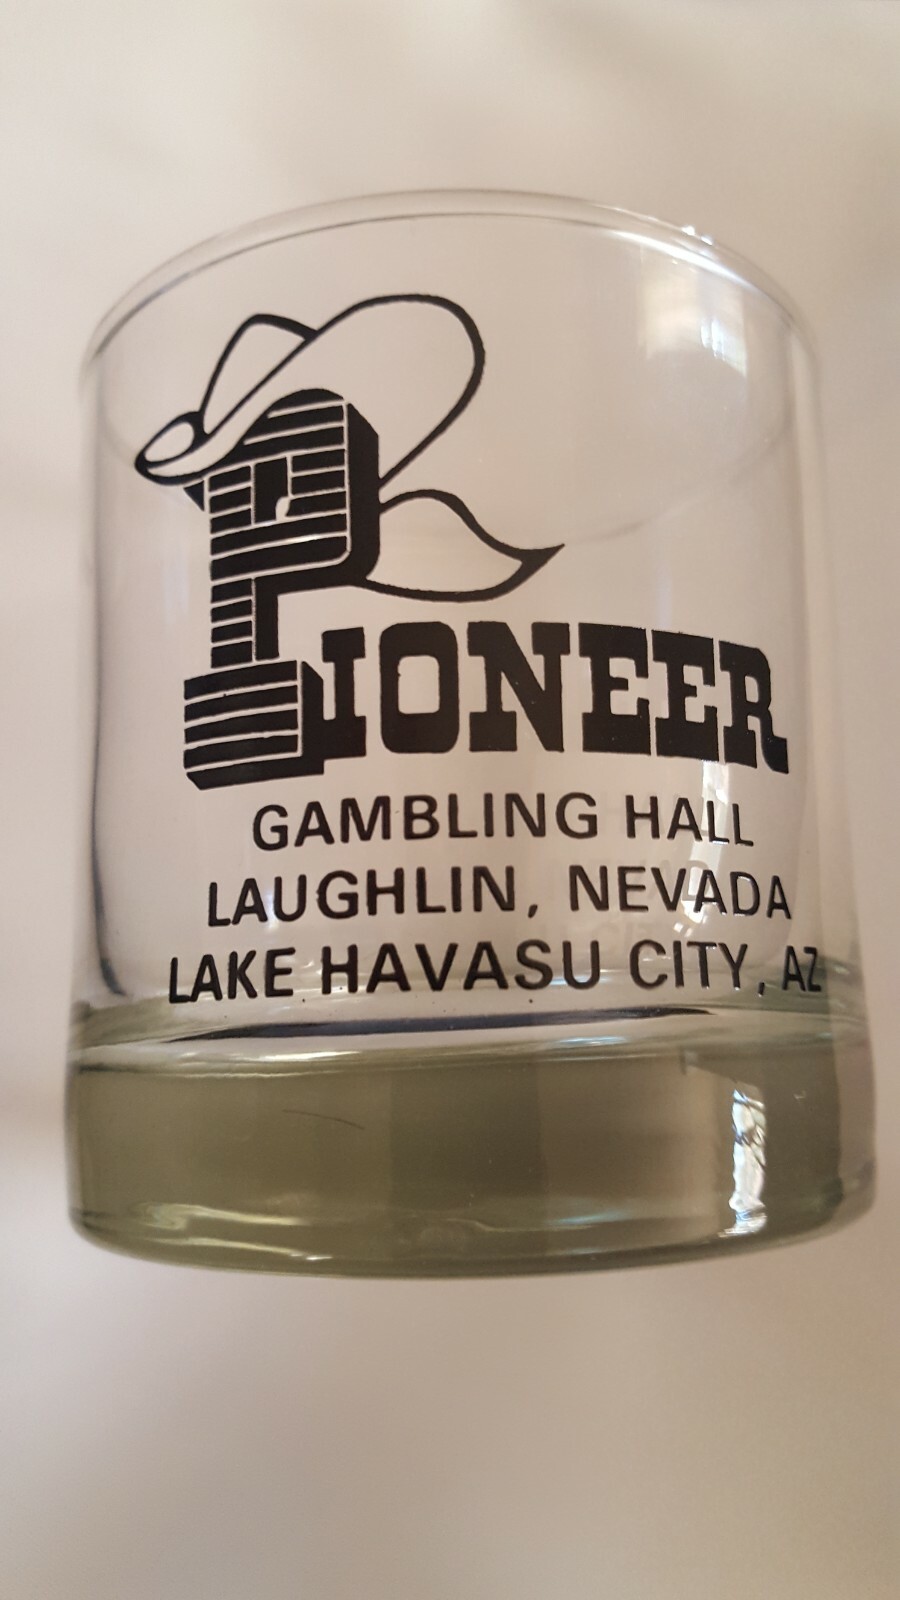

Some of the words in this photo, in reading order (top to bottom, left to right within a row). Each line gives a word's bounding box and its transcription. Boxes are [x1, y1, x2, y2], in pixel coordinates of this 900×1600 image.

[184, 388, 790, 790] PIONEER
[252, 792, 599, 852] GAMBLING
[625, 795, 756, 848] HALL
[207, 865, 539, 928] LAUGHLIN,
[568, 864, 793, 921] NEVADA
[168, 946, 297, 1005] LAKE
[321, 939, 601, 996] HAVASU
[628, 938, 767, 998] CITY,
[780, 945, 824, 993] AZ
